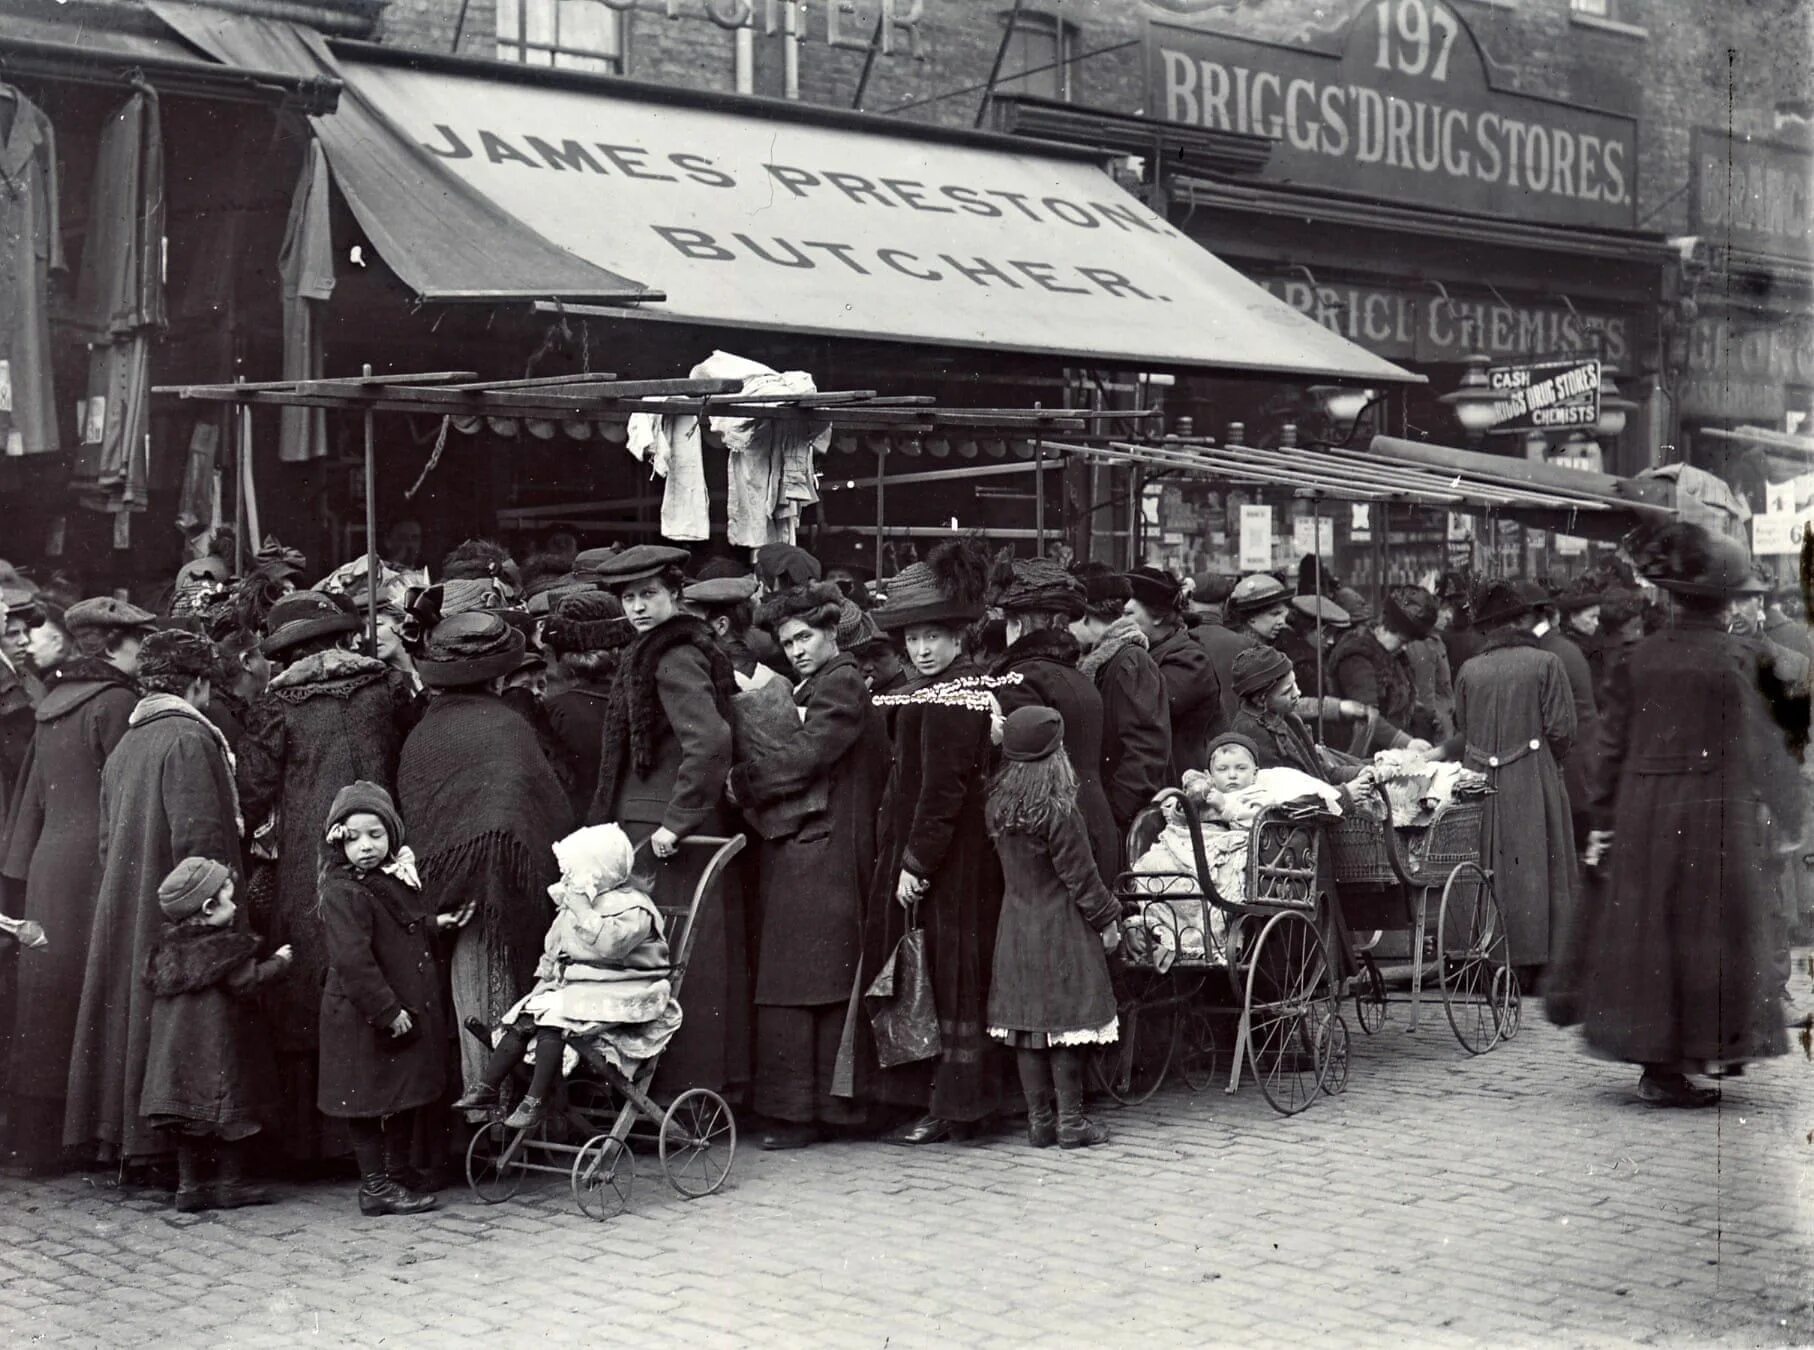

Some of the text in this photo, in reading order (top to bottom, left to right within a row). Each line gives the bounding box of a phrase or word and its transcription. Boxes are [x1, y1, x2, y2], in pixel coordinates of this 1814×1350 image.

[1373, 0, 1459, 82] 197
[421, 123, 1178, 239] JAMES PRESTON.
[1355, 88, 1470, 177] DRUG
[1476, 111, 1631, 204] STORES.
[651, 225, 1174, 302] BUTCHER.
[1428, 297, 1627, 360] CHEMISTS
[1492, 371, 1531, 389] CASH
[1526, 379, 1556, 412] DRUG
[1555, 364, 1598, 400] STORES
[1532, 405, 1596, 425] CHEMISTS
